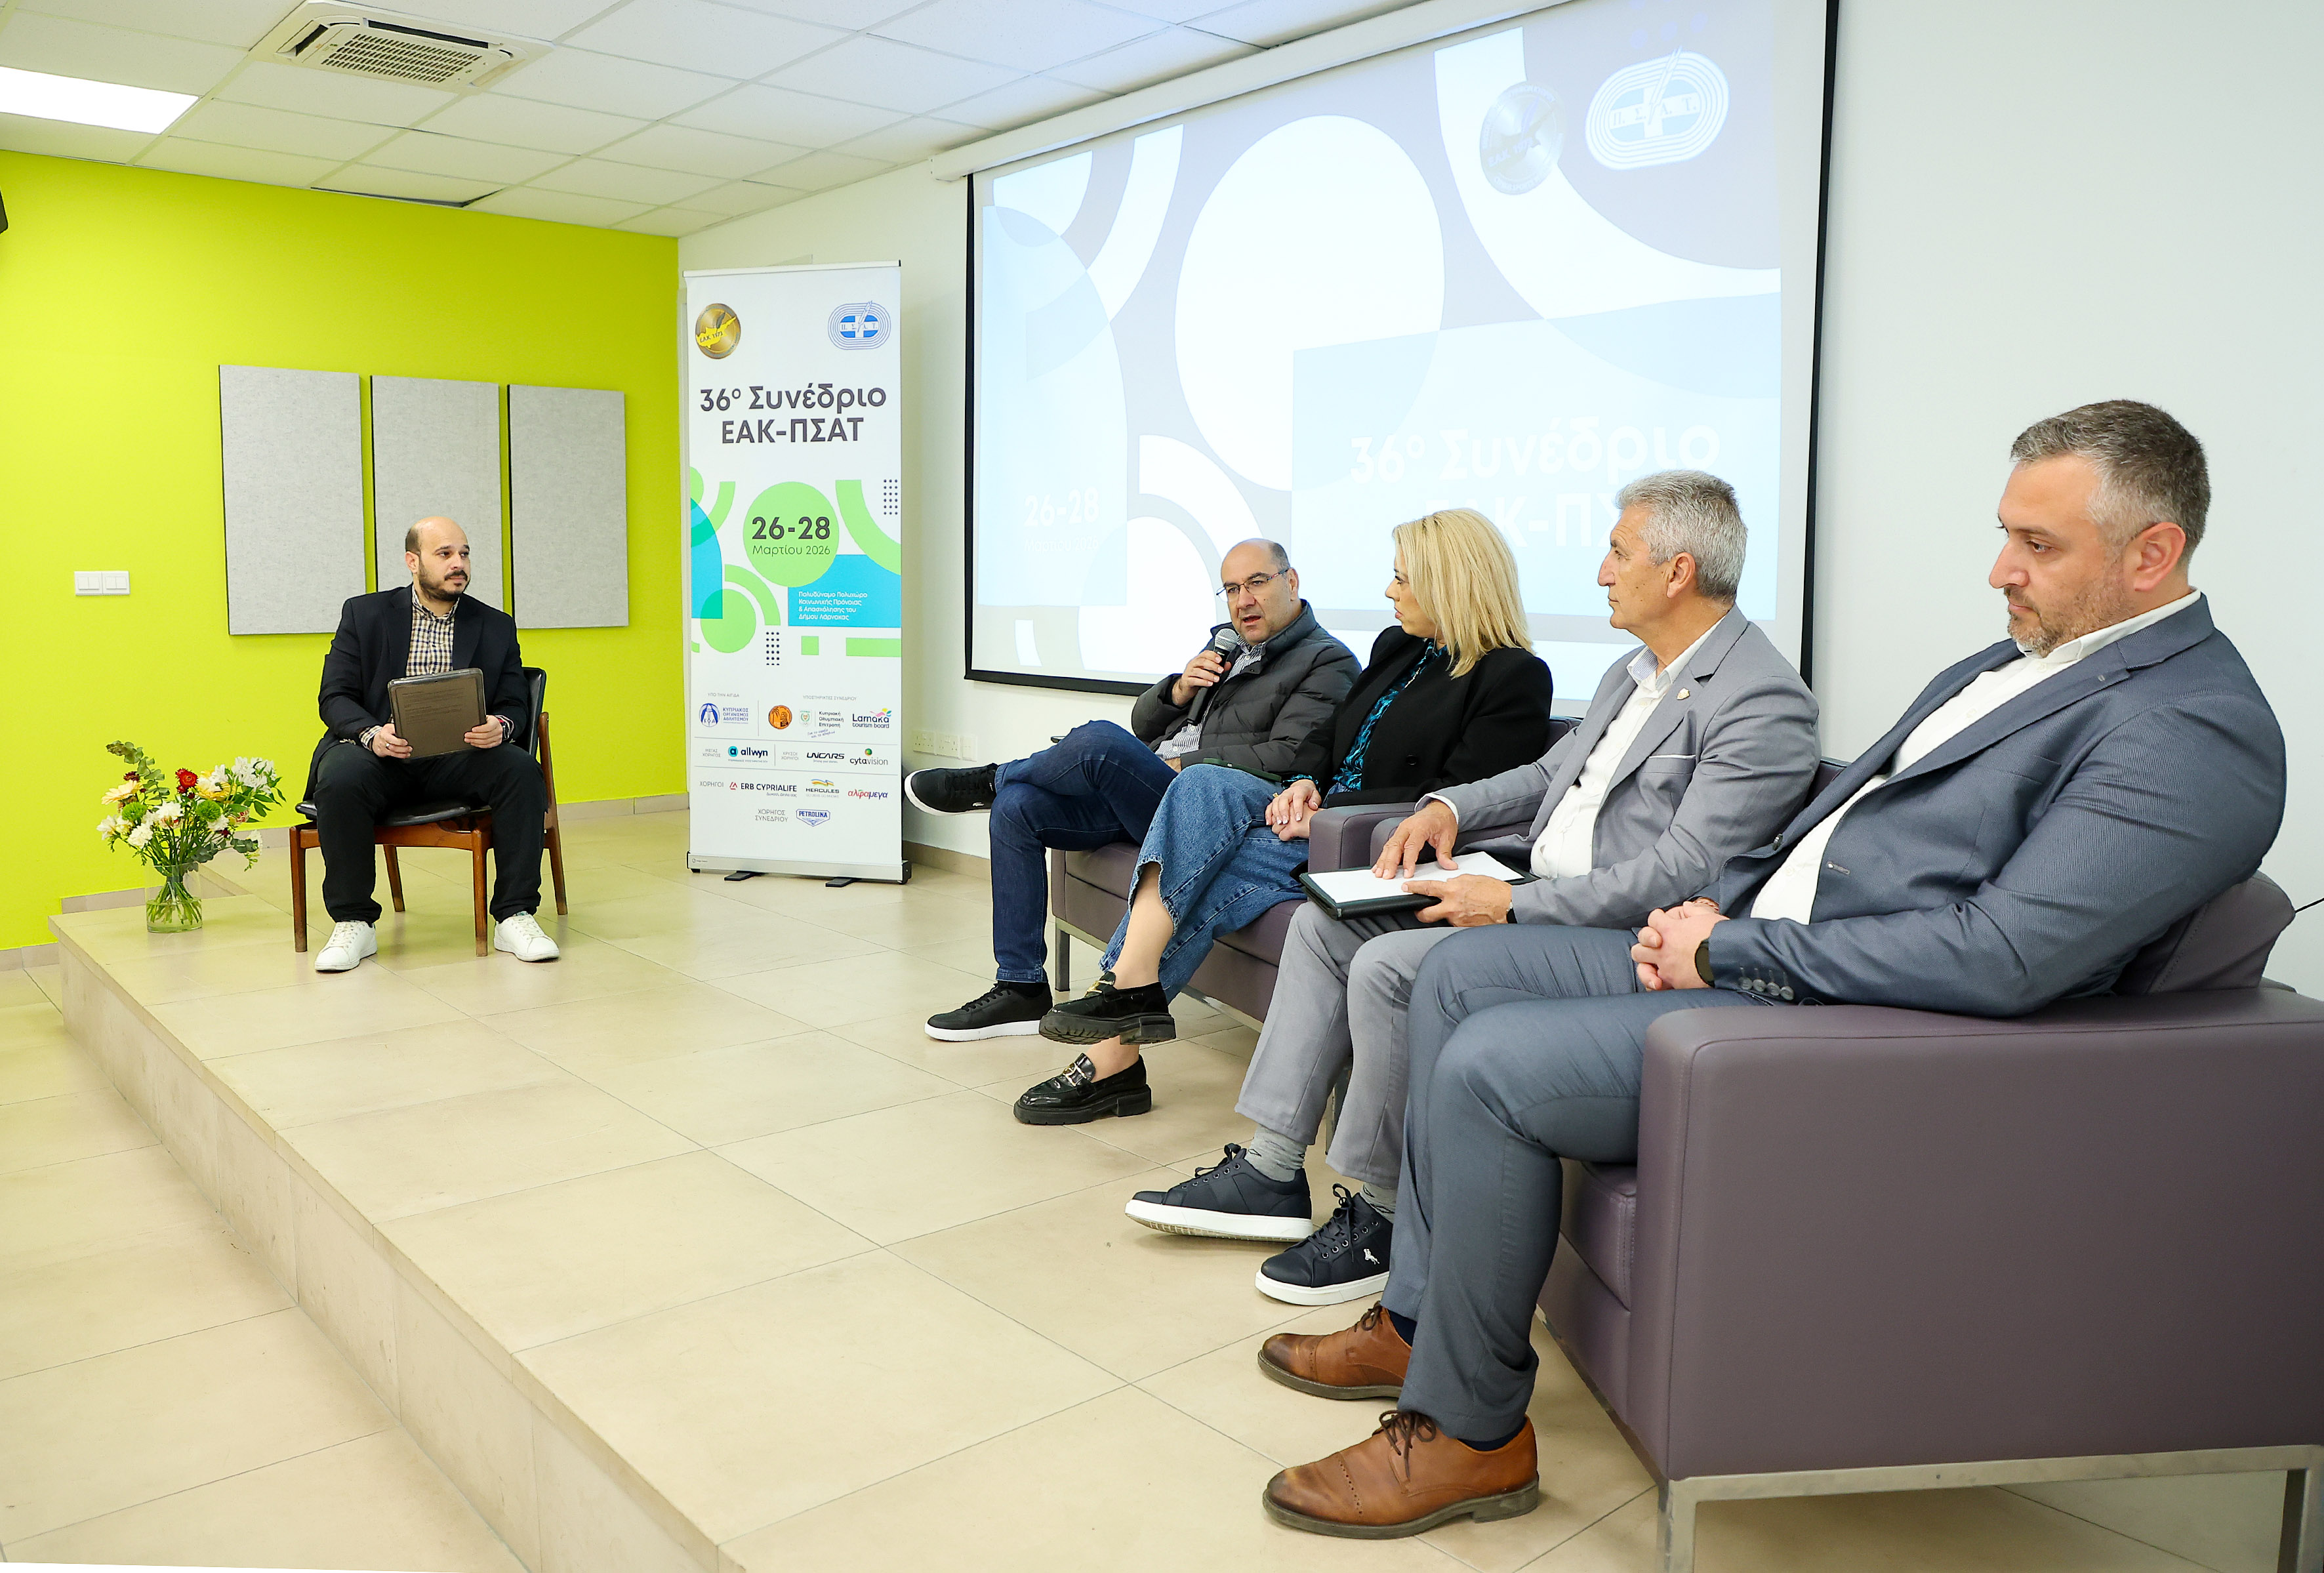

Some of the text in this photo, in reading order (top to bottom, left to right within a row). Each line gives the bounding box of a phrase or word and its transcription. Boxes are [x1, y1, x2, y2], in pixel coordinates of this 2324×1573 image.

[748, 382, 887, 414] Συνέδριο
[722, 417, 865, 444] ΕΑΚ-ΠΣΑΤ
[1438, 415, 1721, 485] Συνέδριο
[1023, 486, 1100, 527] 26-28
[752, 516, 830, 540] 26-28
[752, 544, 830, 557] Μαρτίου 2026
[852, 713, 889, 723] Larnaka
[741, 746, 768, 758] allwyn
[849, 757, 888, 766] cytavision
[756, 783, 798, 792] CYPRIALIFE
